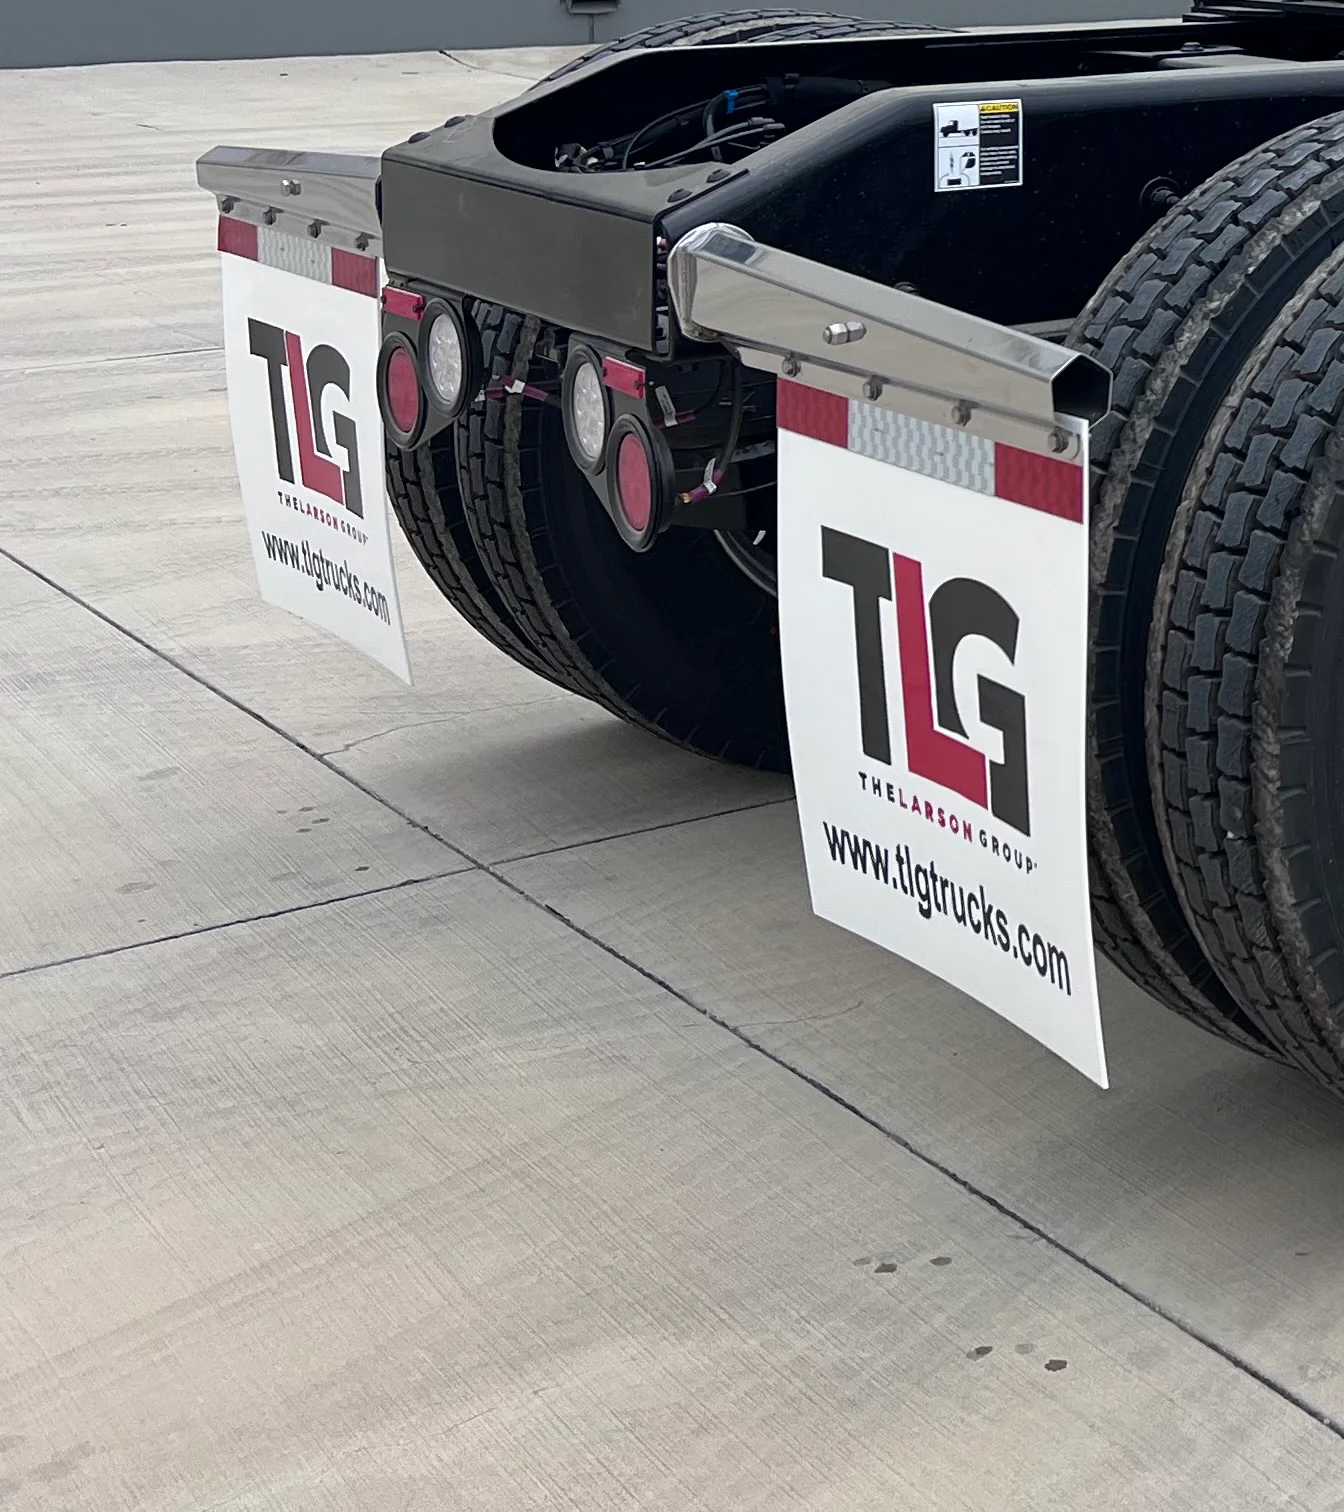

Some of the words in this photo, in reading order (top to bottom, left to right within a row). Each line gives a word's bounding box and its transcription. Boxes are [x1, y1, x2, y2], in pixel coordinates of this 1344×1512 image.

[247, 316, 364, 519] TLG
[261, 530, 391, 625] www.tlgtrucks.com
[340, 520, 368, 545] GROUP
[820, 524, 1031, 837] TLG
[858, 771, 895, 803] THE
[898, 788, 973, 843] LARSON
[979, 829, 1034, 874] GROUP
[822, 821, 1071, 996] www.tlgtrucks.com
